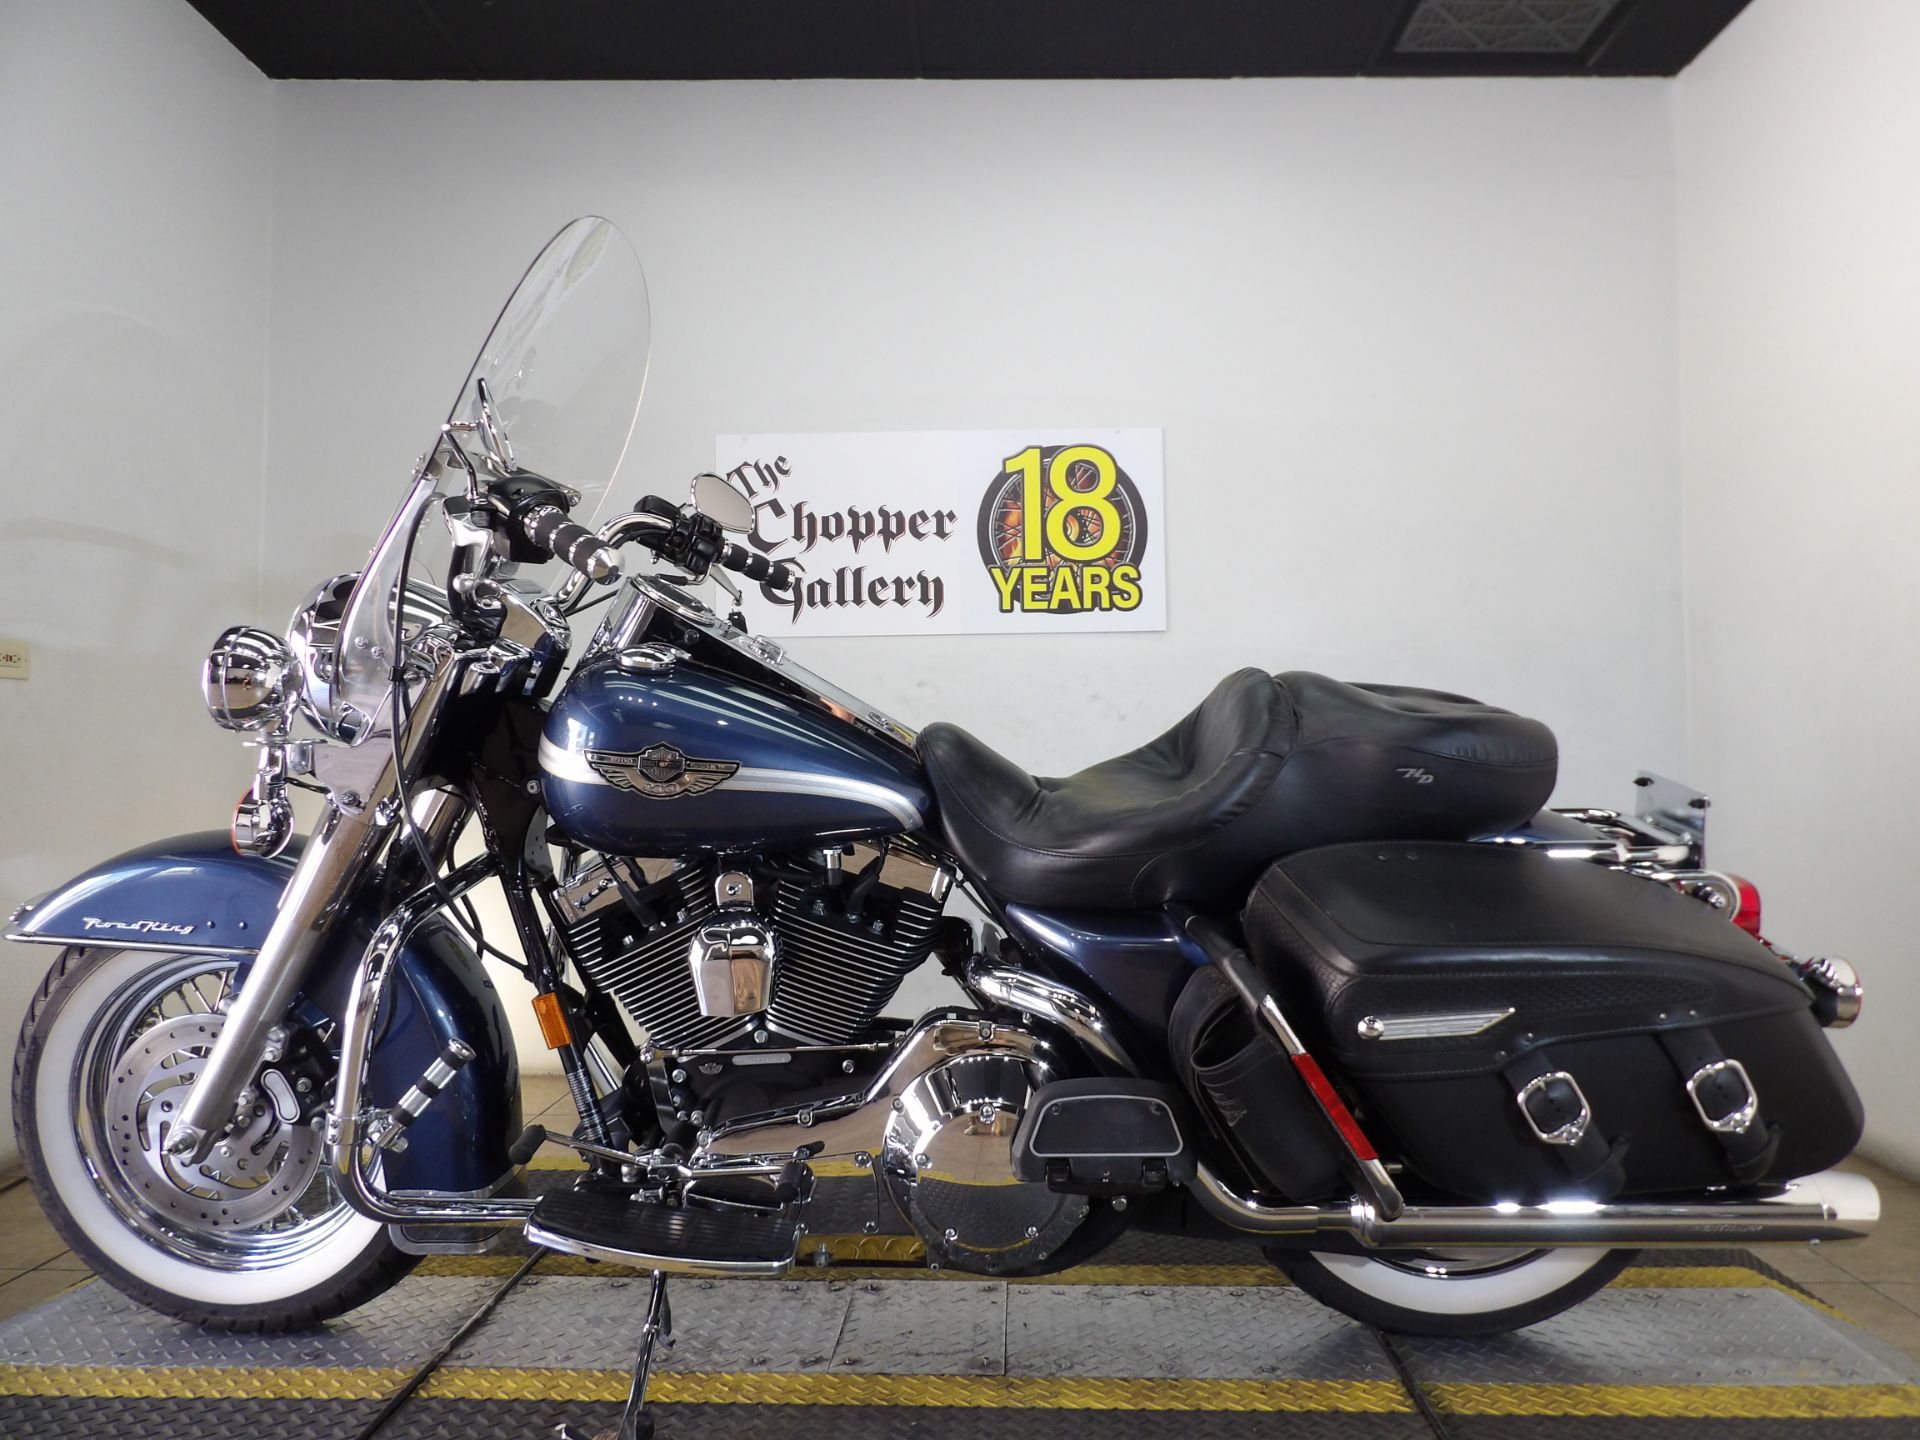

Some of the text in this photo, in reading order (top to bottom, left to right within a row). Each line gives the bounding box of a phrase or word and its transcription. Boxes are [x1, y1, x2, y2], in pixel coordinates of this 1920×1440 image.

[726, 455, 792, 500] The
[1003, 446, 1121, 562] 18
[747, 497, 957, 555] Chopper
[992, 564, 1142, 613] YEARS
